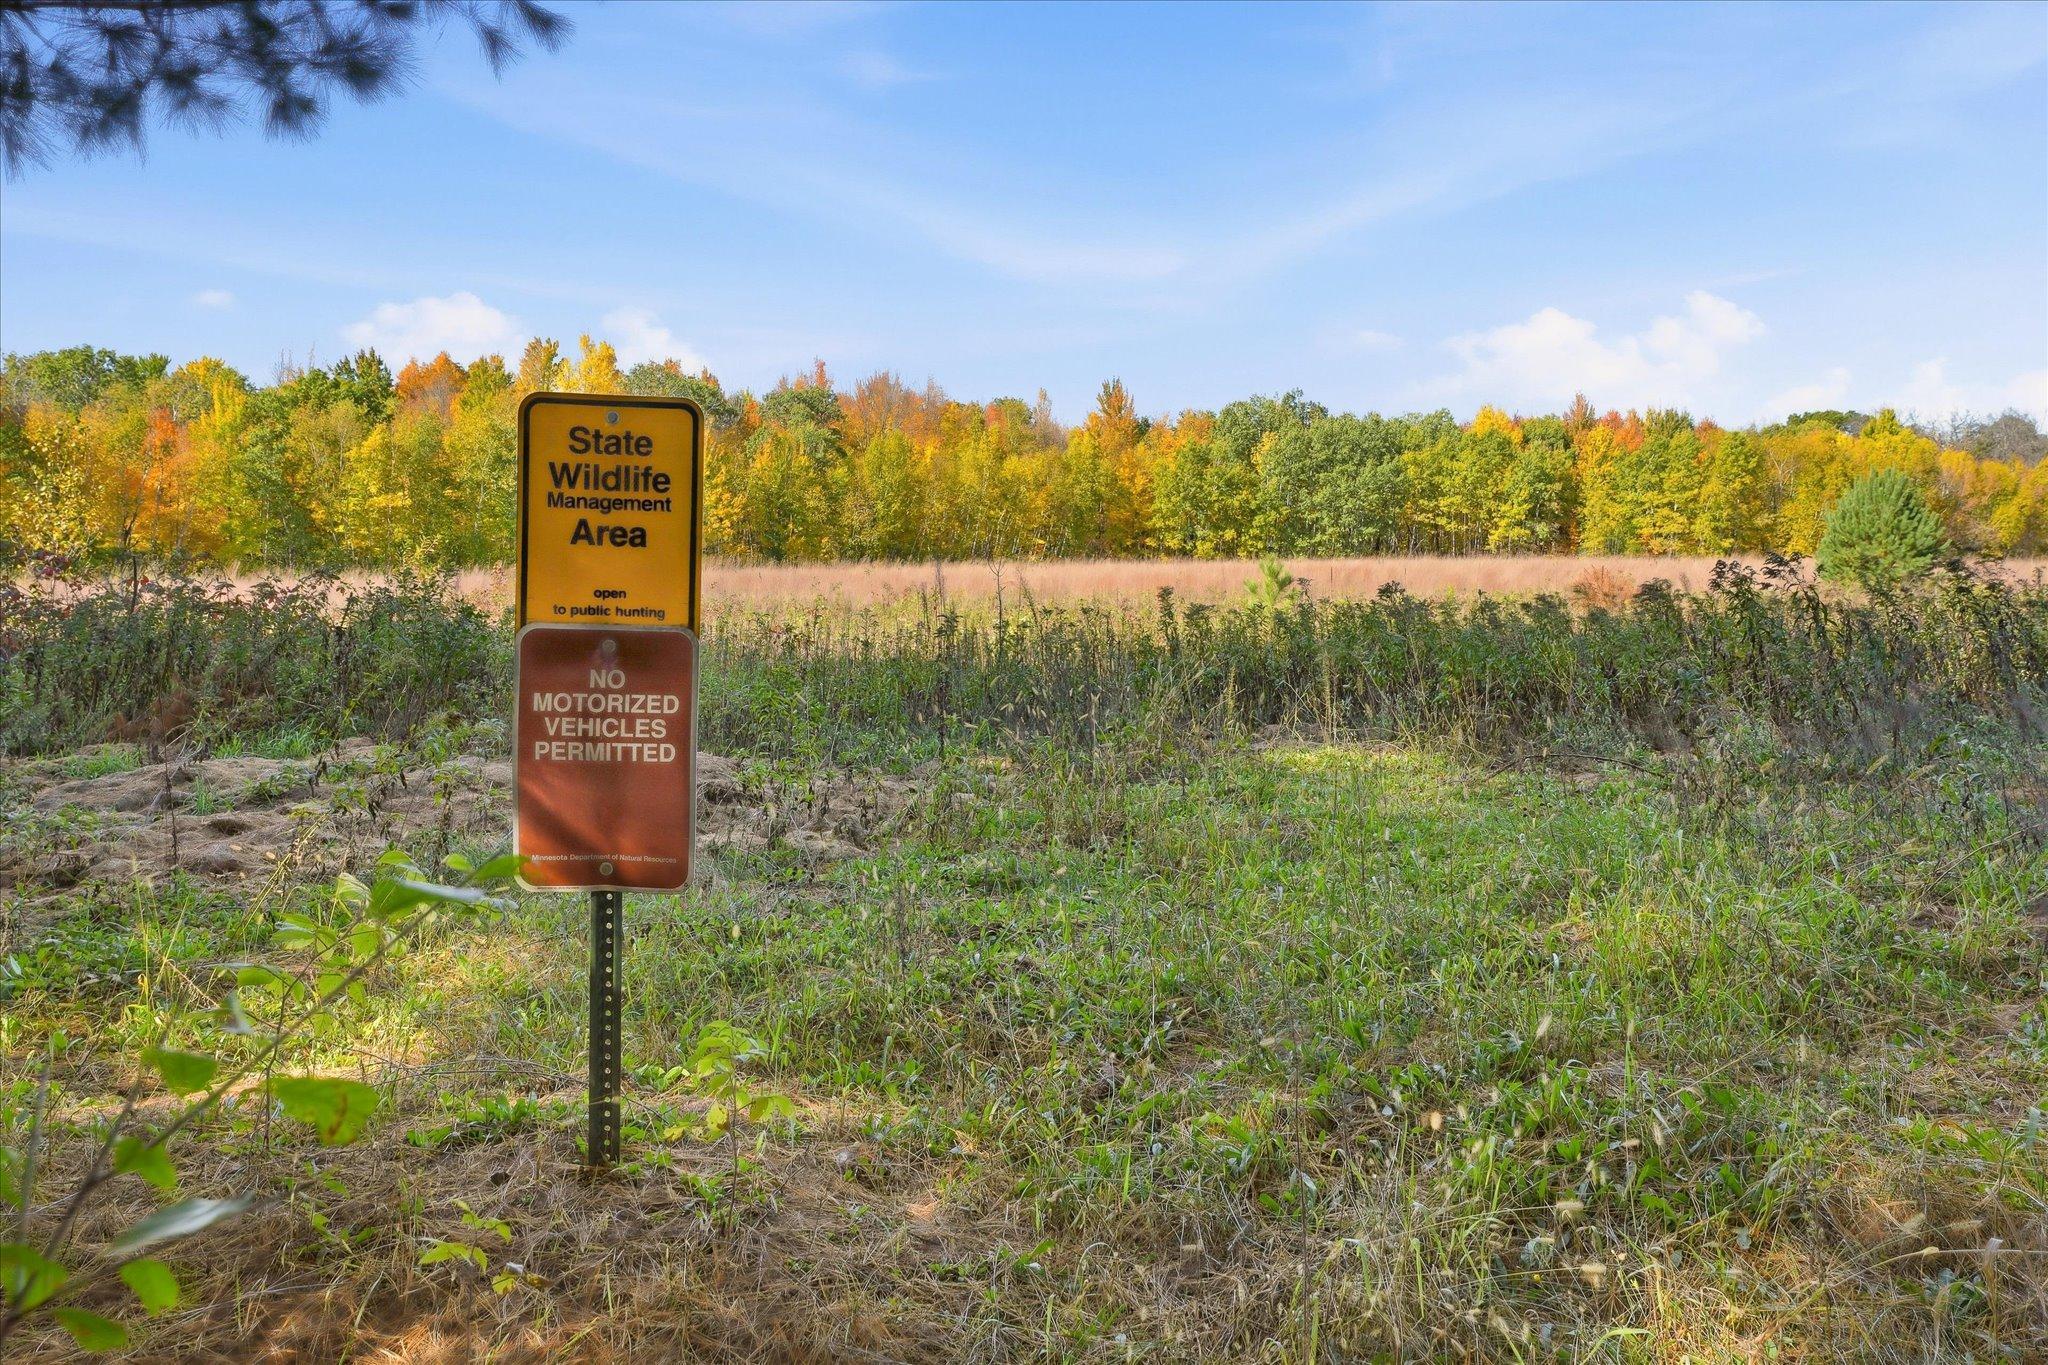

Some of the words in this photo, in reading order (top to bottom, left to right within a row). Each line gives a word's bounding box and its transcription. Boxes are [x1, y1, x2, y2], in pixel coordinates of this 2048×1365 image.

[568, 426, 653, 456] State
[548, 462, 671, 493] Wildlife
[547, 491, 672, 514] Management
[570, 518, 647, 548] Area
[593, 589, 627, 600] open
[553, 605, 566, 615] to
[570, 605, 611, 617] public
[615, 606, 665, 620] hunting
[589, 669, 626, 689] NO
[532, 692, 680, 714] MOTORIZED
[544, 717, 667, 739] VEHICLES
[534, 741, 676, 763] PERMITTED
[531, 854, 568, 862] Minnesota
[569, 854, 611, 863] Department
[619, 854, 643, 863] Natural
[643, 855, 677, 864] Resources
